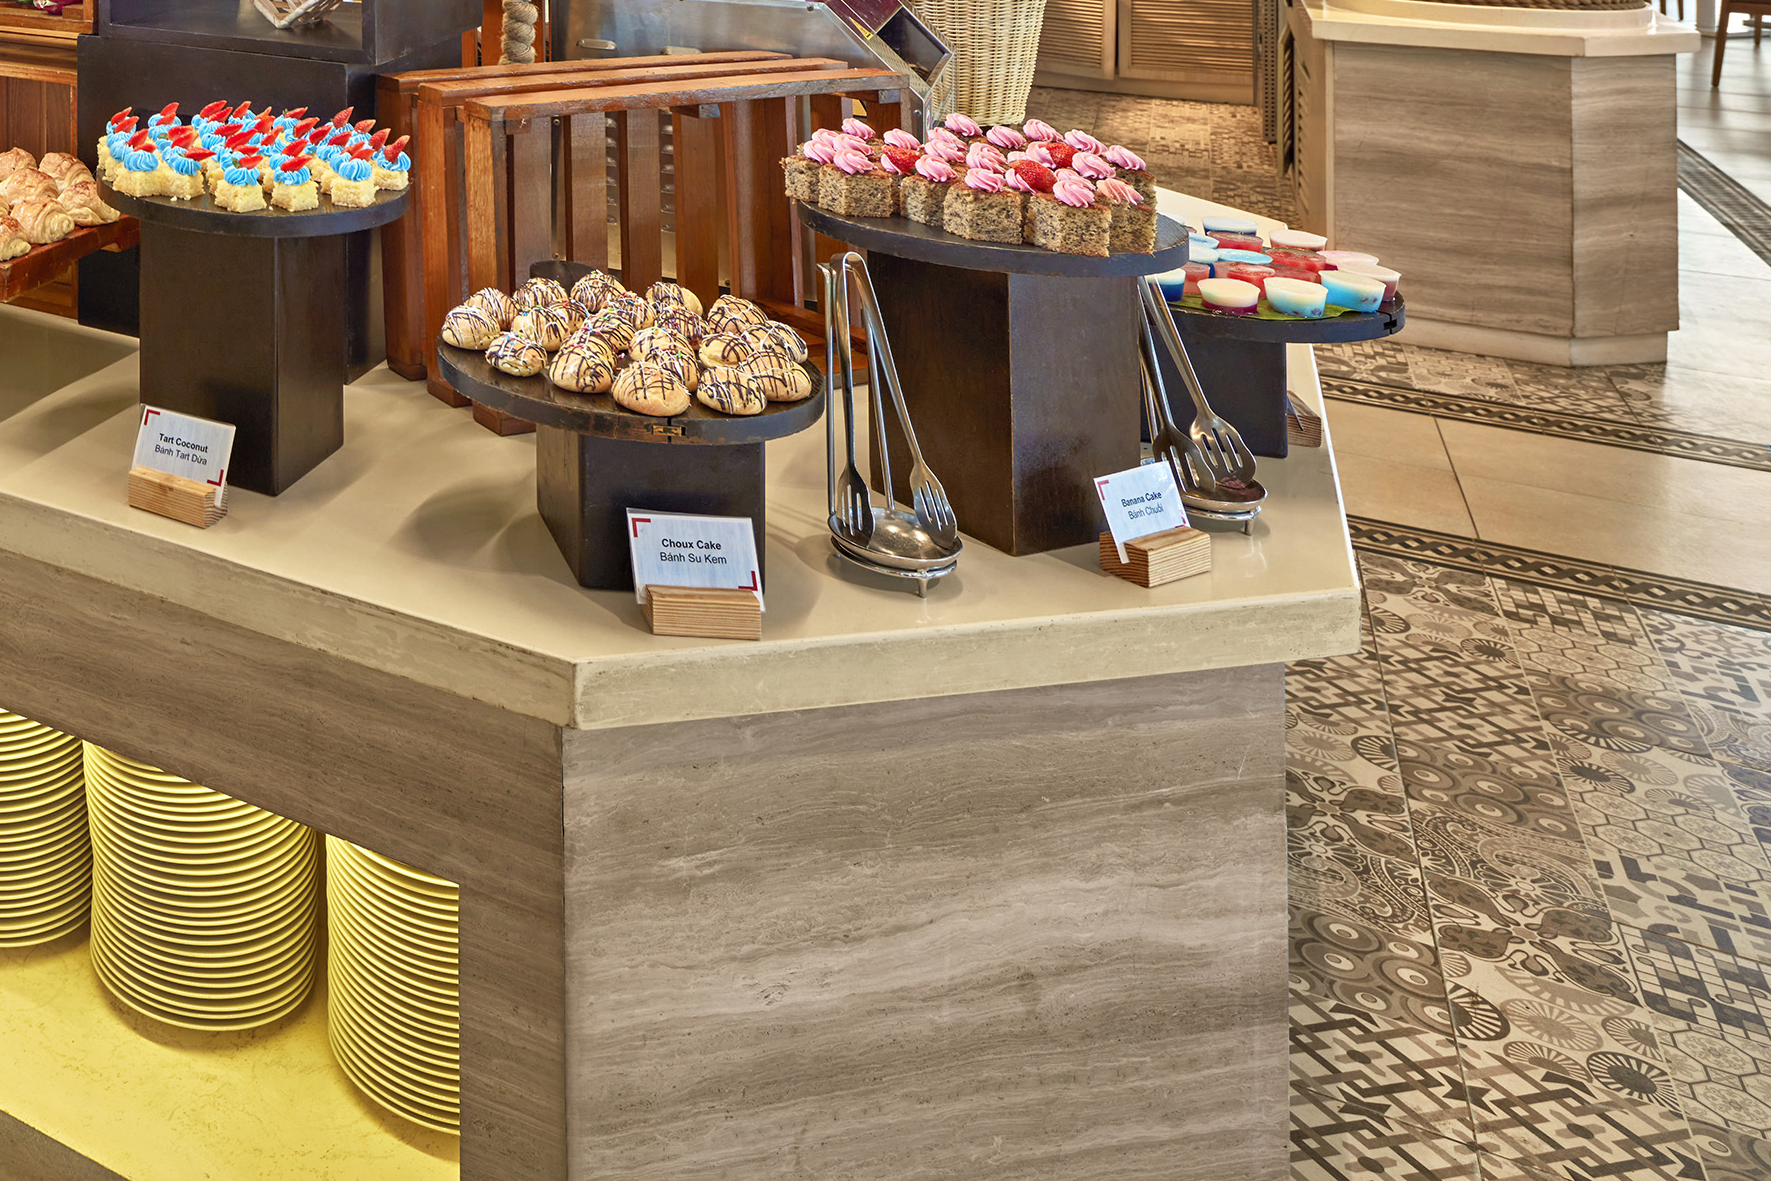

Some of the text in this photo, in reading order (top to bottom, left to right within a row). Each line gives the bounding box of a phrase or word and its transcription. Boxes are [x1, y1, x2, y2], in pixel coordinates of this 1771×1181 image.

[159, 433, 208, 453] Tart Coconut
[154, 444, 174, 456] Bánh
[176, 450, 190, 460] Tart
[1121, 492, 1162, 508] Banana Cake
[1128, 502, 1164, 520] Bánh Chuối
[661, 538, 722, 550] Choux Cake
[660, 552, 727, 564] Bánh Su Kem
